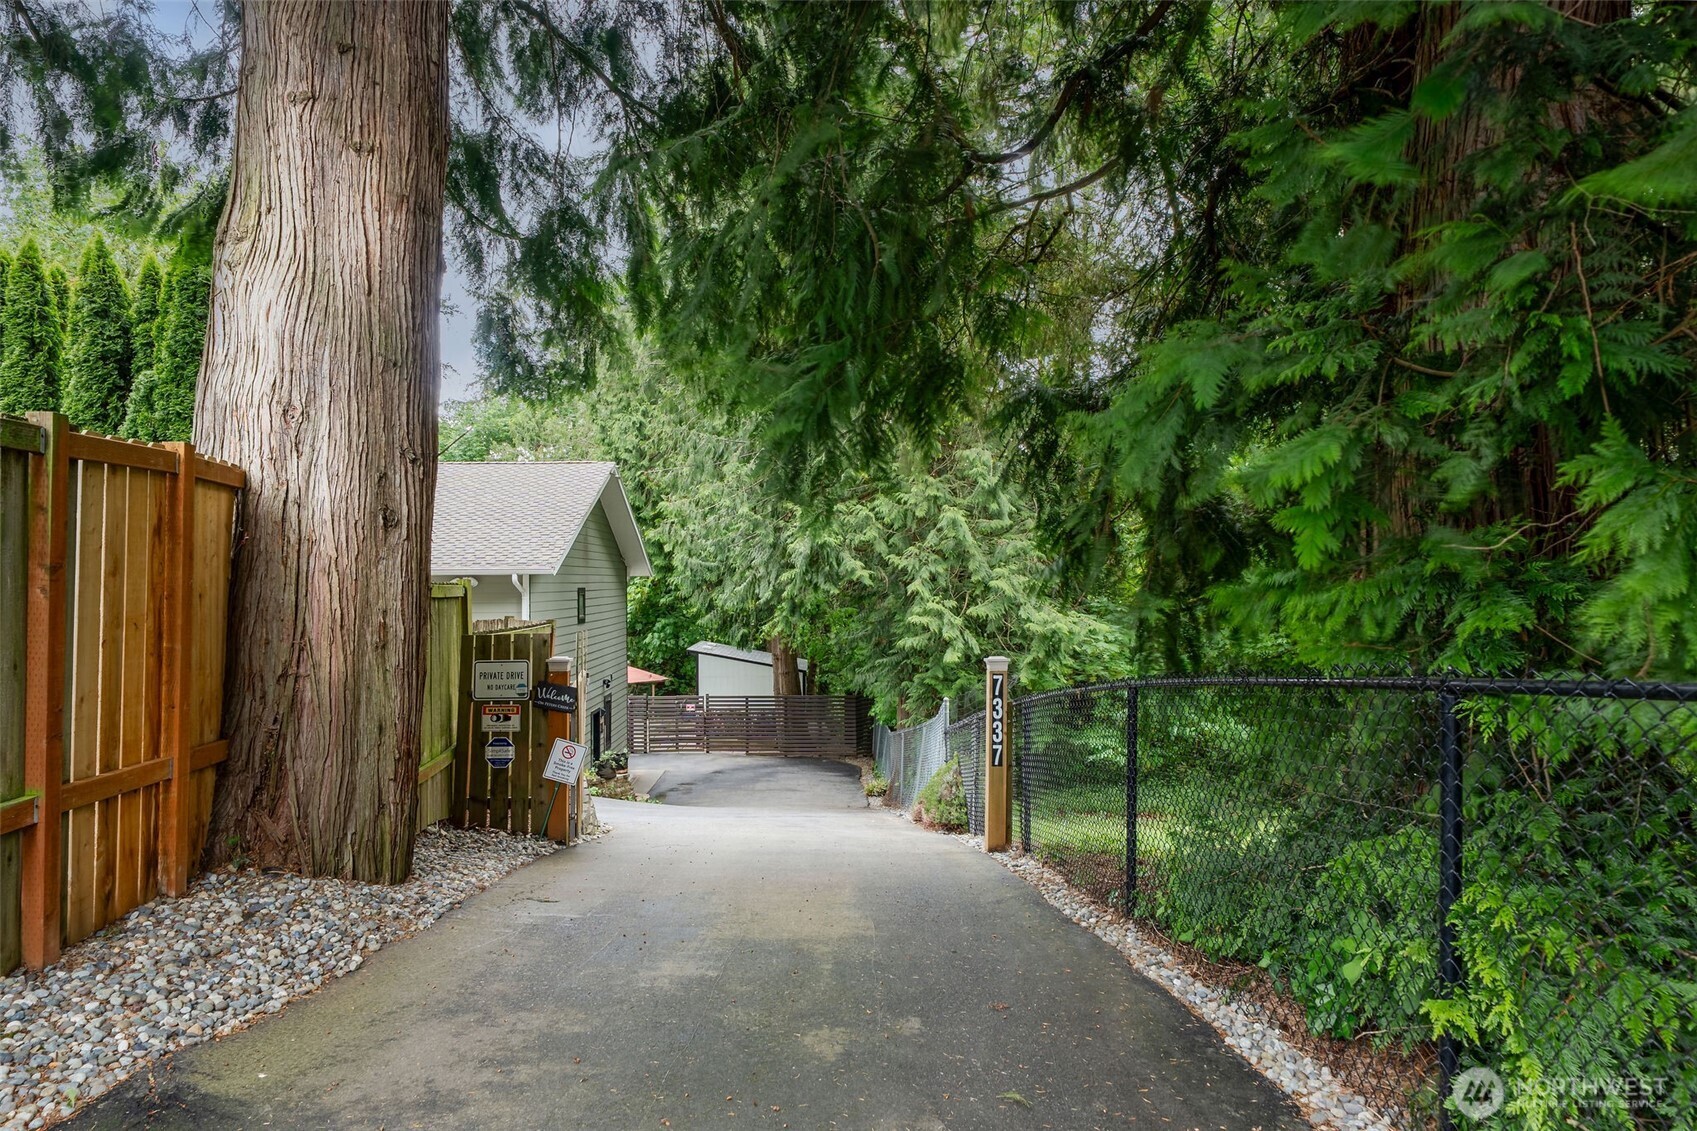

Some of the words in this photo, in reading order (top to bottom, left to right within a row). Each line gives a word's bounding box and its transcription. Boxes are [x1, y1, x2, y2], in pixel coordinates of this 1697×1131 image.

[480, 672, 504, 680] PRIVATE
[506, 671, 524, 680] DRIVE
[992, 674, 1003, 766] 7337
[554, 765, 571, 774] Property
